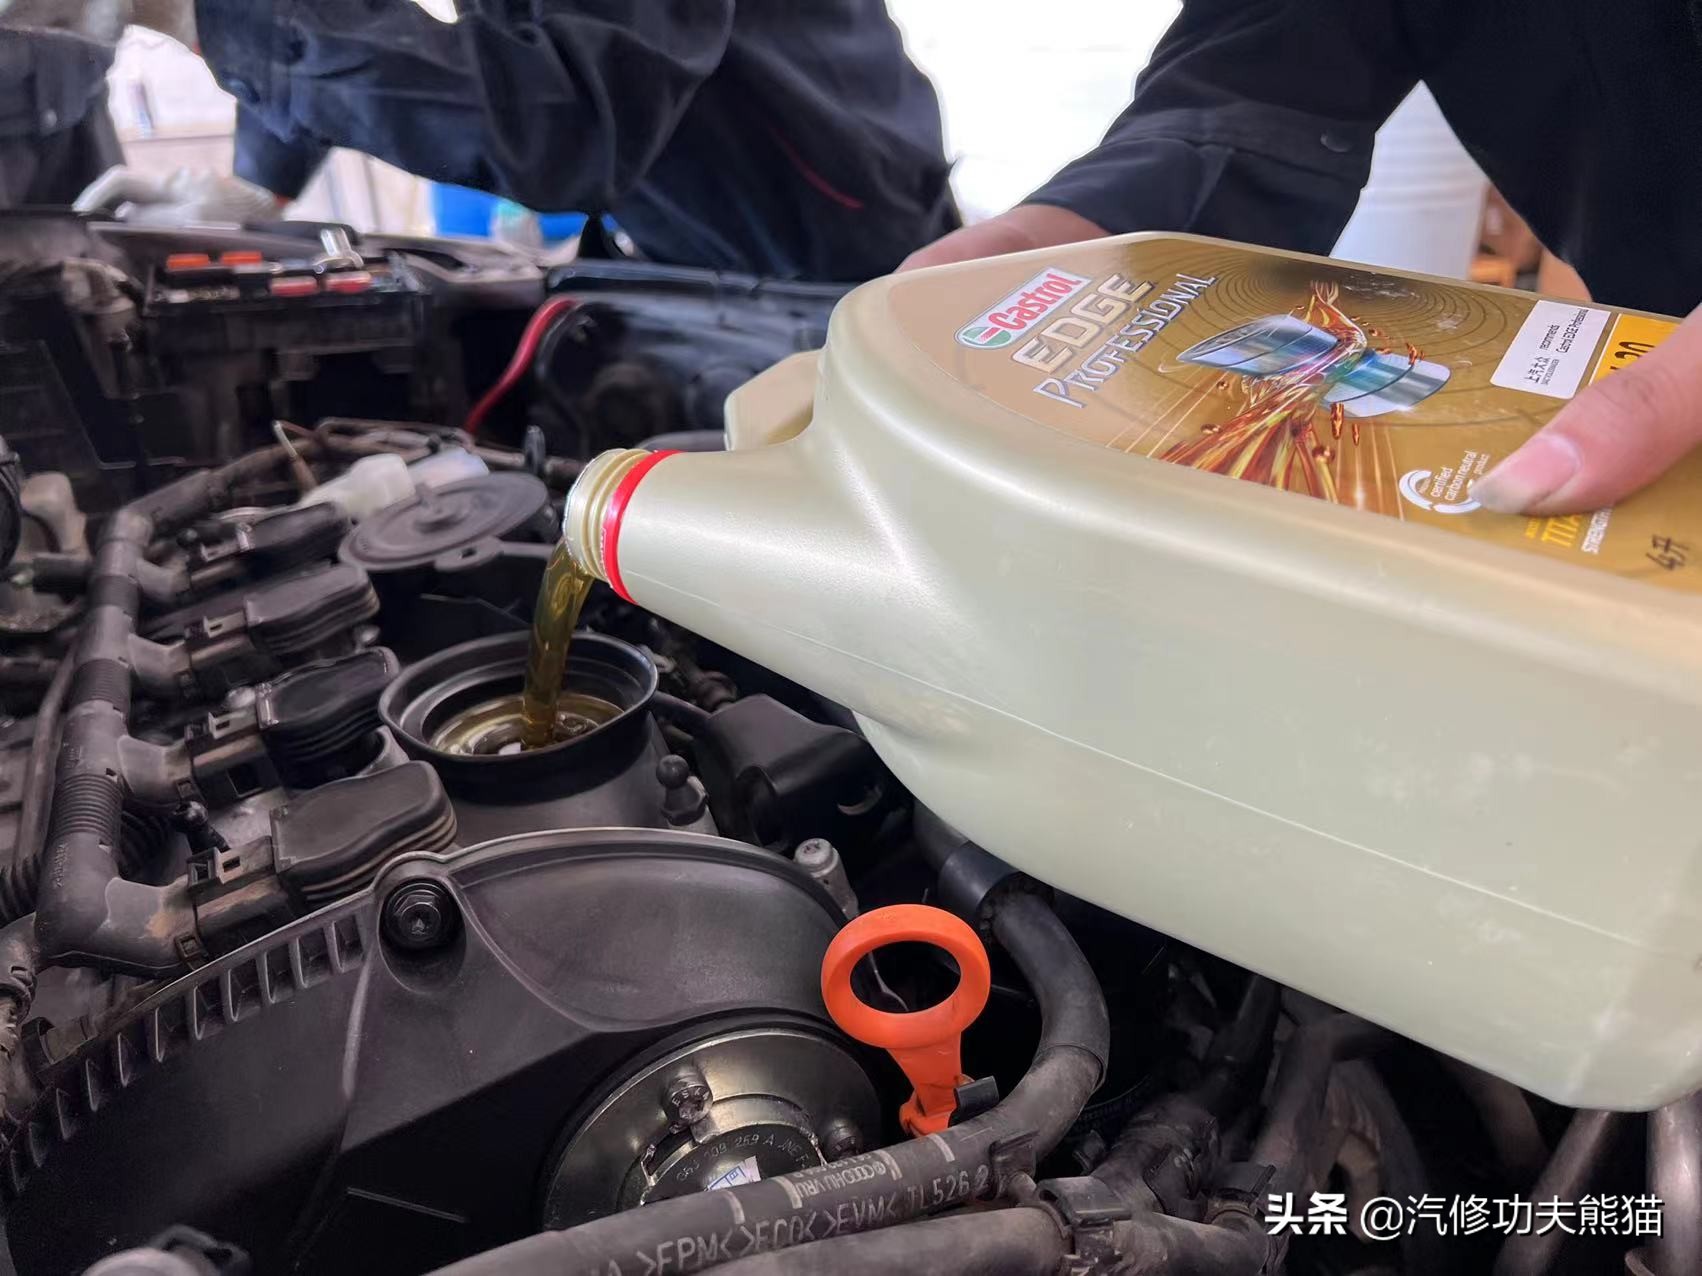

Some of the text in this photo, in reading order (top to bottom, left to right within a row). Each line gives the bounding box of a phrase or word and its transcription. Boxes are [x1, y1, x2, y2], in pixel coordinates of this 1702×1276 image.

[988, 272, 1081, 331] Castrol
[1011, 272, 1155, 373] EDGE
[1033, 272, 1218, 409] PROFESSIONAL
[1430, 466, 1453, 497] certified
[1444, 449, 1478, 501] carbon neutral
